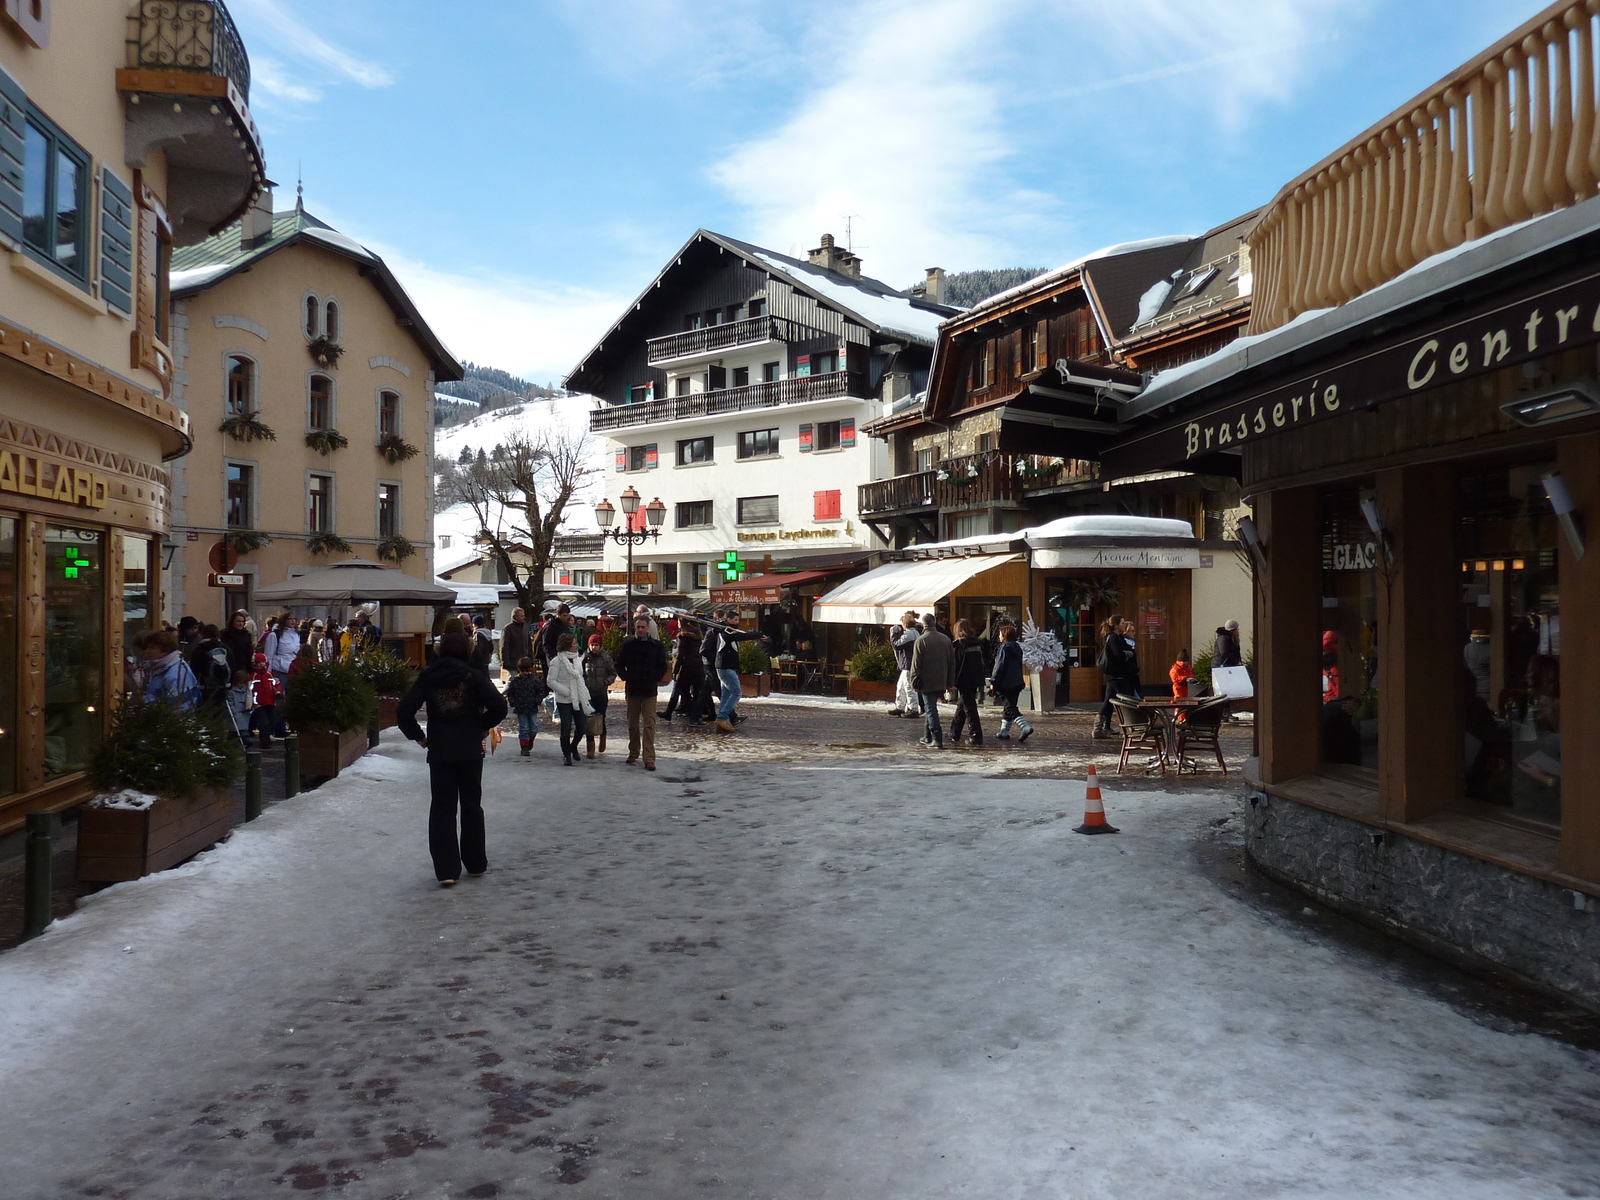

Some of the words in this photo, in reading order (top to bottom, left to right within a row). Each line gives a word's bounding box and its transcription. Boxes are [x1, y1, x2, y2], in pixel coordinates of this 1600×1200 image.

[1184, 379, 1341, 460] Brasserie
[737, 532, 777, 543] Banque
[779, 527, 839, 541] Laydernier
[1092, 550, 1134, 566] Avenue
[1136, 551, 1184, 566] Montagne
[1333, 542, 1377, 571] GLAC
[600, 573, 611, 583] LE
[615, 573, 652, 583] CITRA
